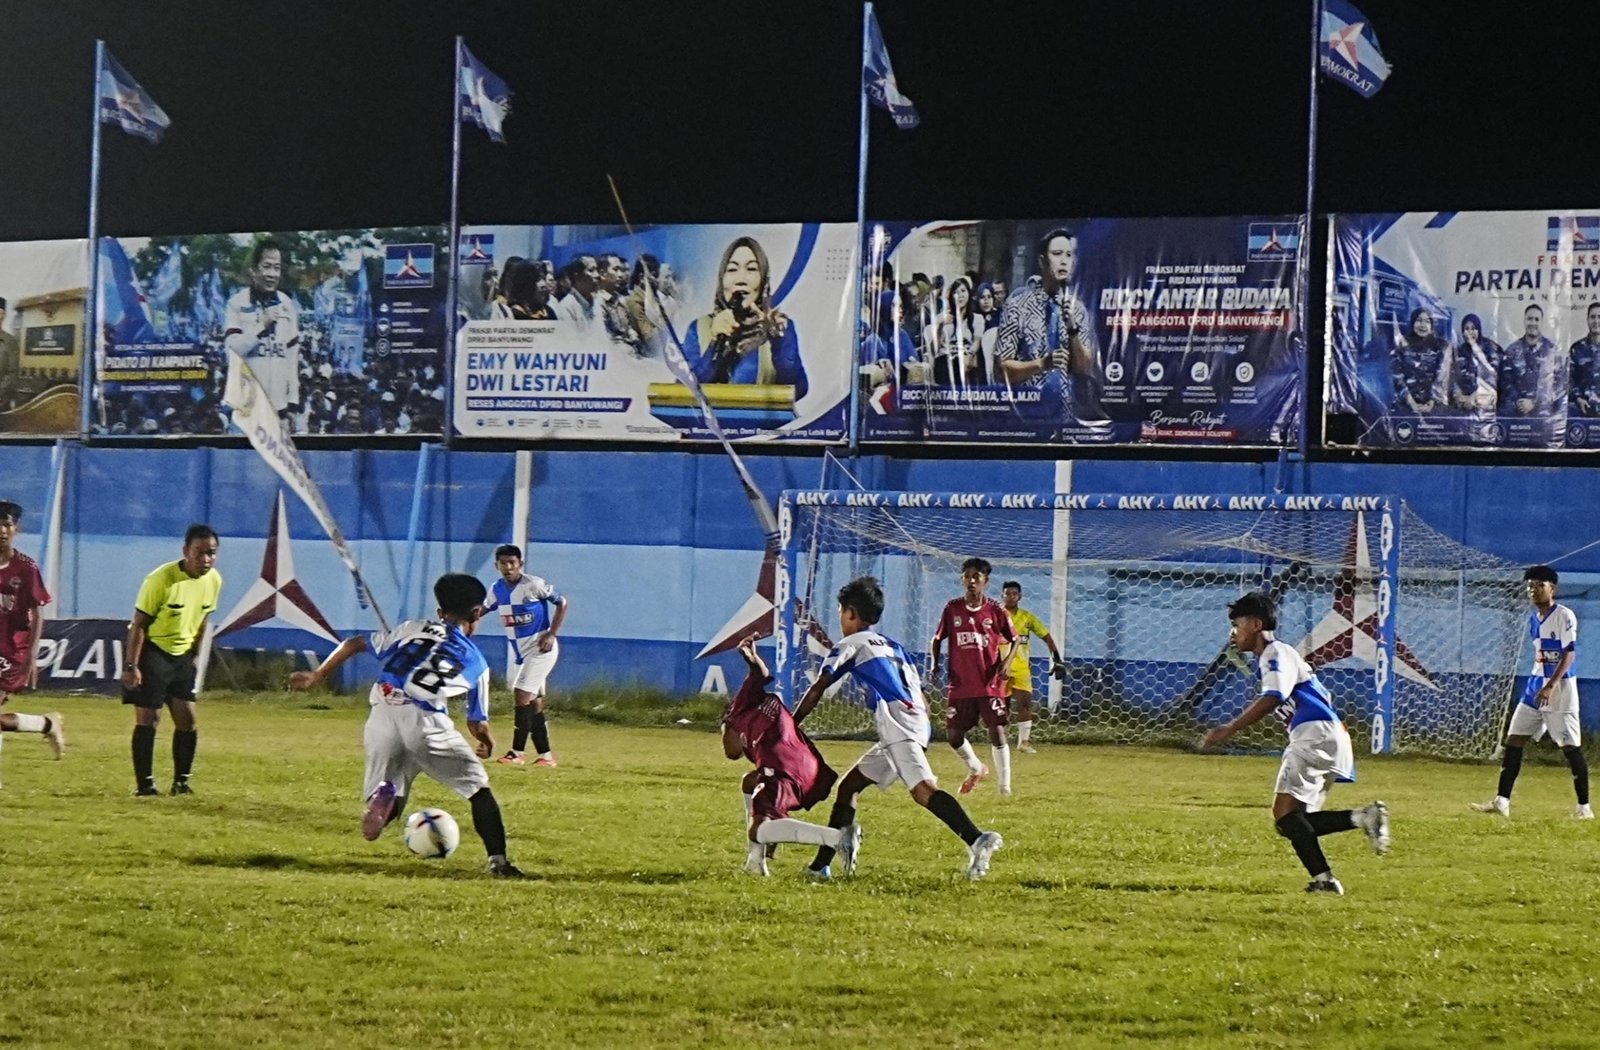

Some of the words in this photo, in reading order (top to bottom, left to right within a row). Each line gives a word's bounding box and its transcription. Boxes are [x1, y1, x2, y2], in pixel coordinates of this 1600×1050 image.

[1455, 268, 1541, 293] PARTAI
[1156, 287, 1218, 310] ANTAR
[1221, 287, 1291, 310] BUDAYA
[1106, 316, 1137, 326] RESES
[1139, 316, 1185, 326] ANGGOTA
[1187, 315, 1216, 326] DPRD
[1218, 315, 1284, 326] BANYUWANGI
[467, 353, 509, 370] EMY
[513, 353, 607, 370] WAHYUNI
[466, 374, 504, 391] DWI
[511, 374, 589, 392] LESTARI
[902, 390, 928, 400] RICCY
[930, 390, 960, 401] ANTAR
[468, 400, 494, 408] RESES
[496, 400, 539, 409] ANGGOTA
[540, 400, 562, 409] DPRD
[564, 400, 624, 410] BANYUWANGI
[796, 492, 829, 506] AHY
[847, 493, 880, 507] AHY
[898, 493, 932, 507] AHY
[949, 494, 983, 508] AHY
[1001, 494, 1036, 508] AHY
[1054, 494, 1090, 509] AHY
[1118, 495, 1155, 510] AHY
[1173, 495, 1210, 510] AHY
[1229, 496, 1266, 510] AHY
[1284, 496, 1322, 510] AHY
[1341, 496, 1380, 511] AHY
